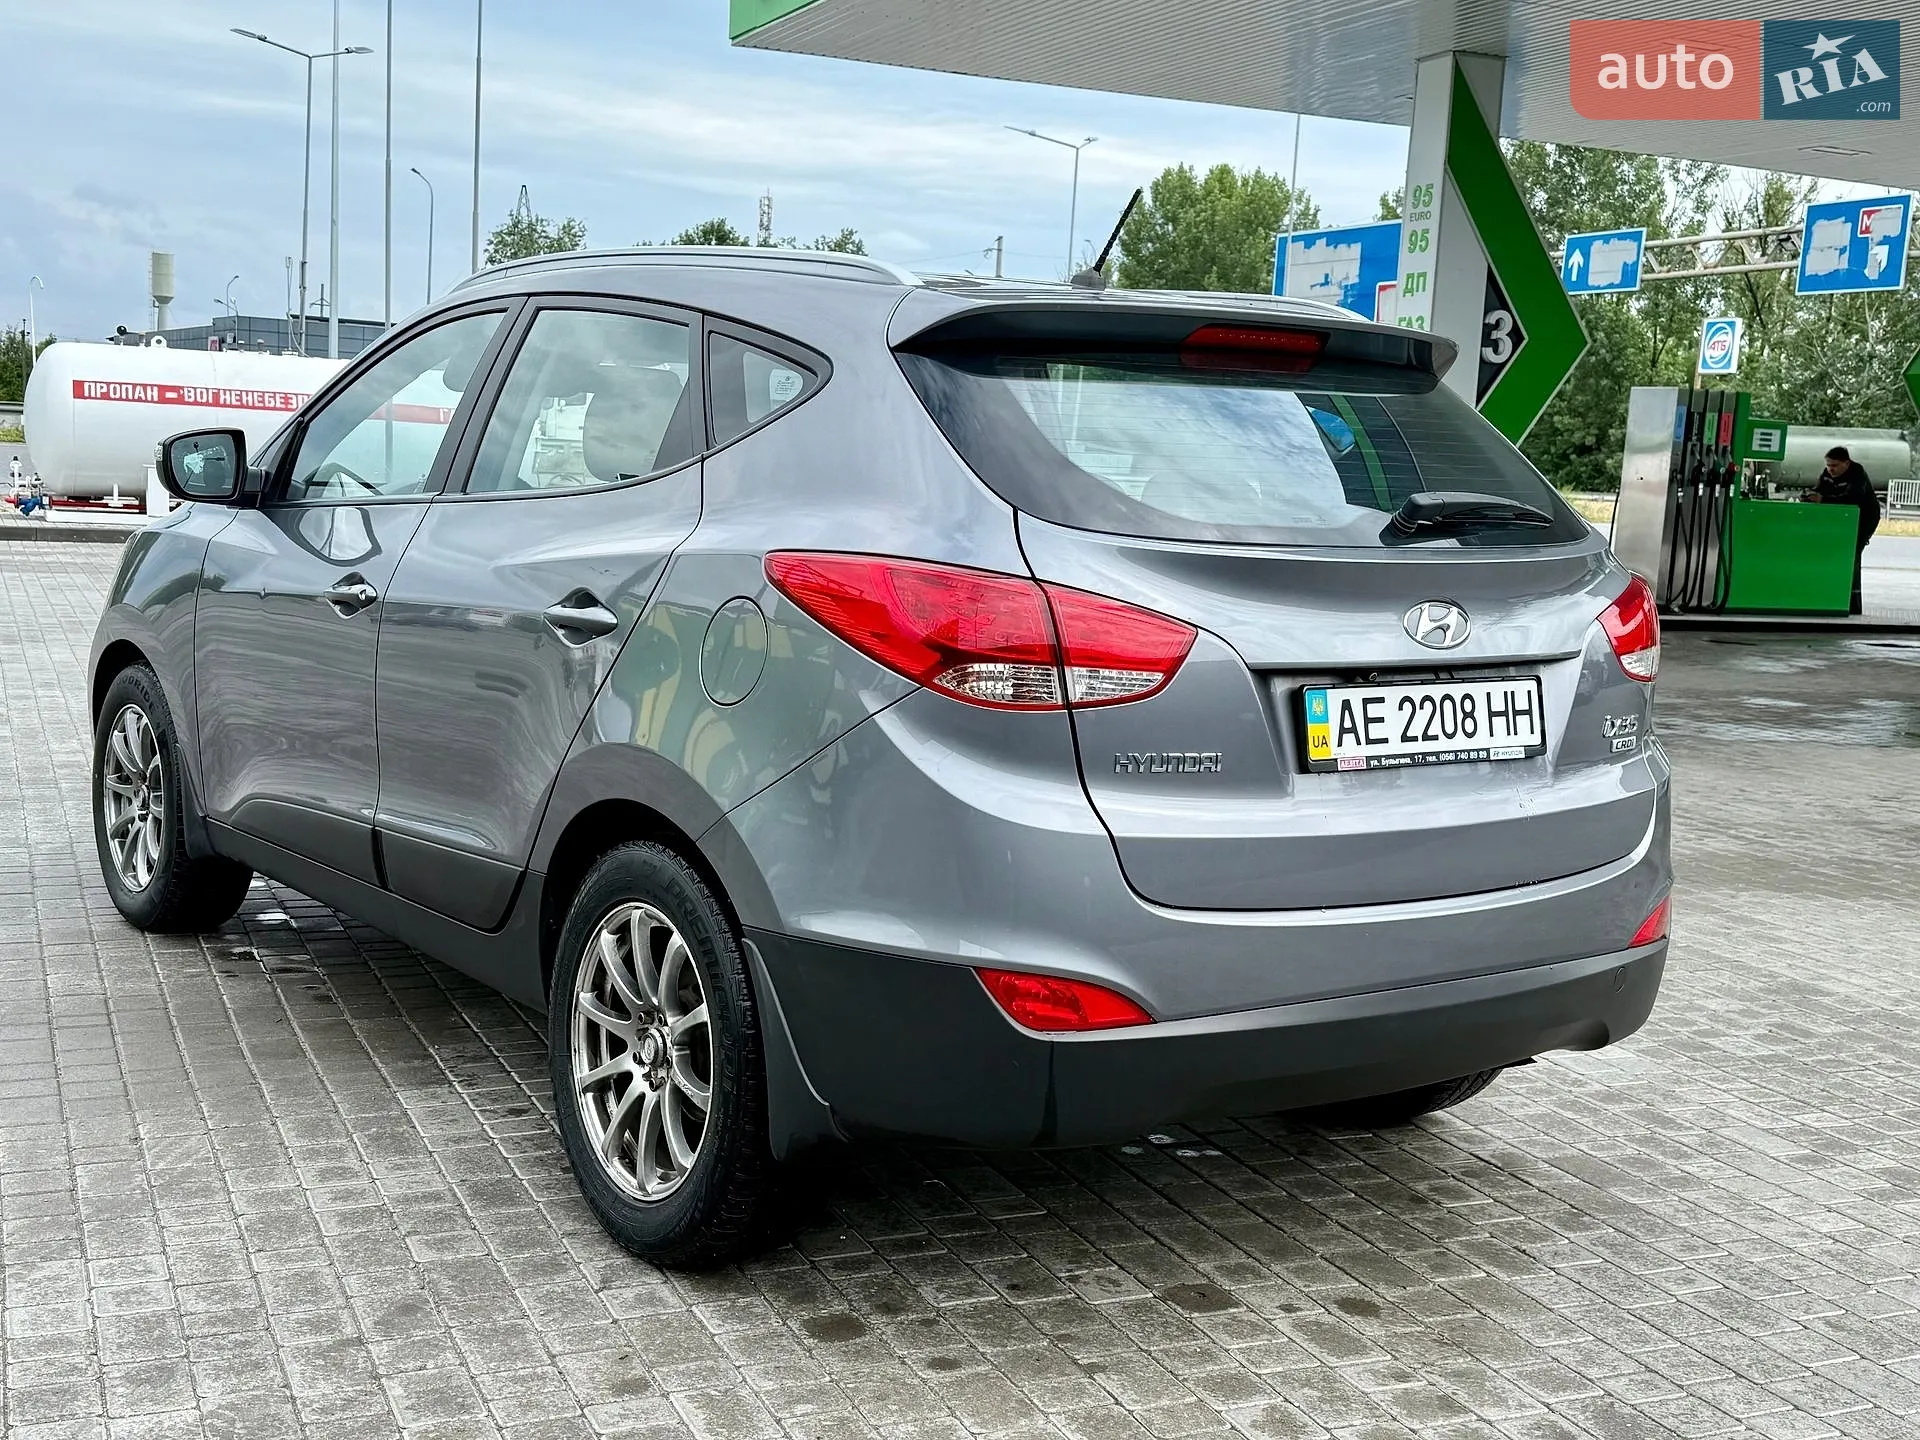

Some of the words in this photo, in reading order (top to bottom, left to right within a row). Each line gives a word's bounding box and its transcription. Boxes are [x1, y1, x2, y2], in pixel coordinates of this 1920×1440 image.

[1411, 183, 1434, 210] 95
[1409, 210, 1432, 222] EURO
[1407, 228, 1430, 254] 95
[1402, 271, 1428, 298] ДП
[1482, 309, 1513, 364] 3
[83, 381, 159, 402] ПРОПАН
[183, 386, 313, 410] ВОГНЕНЕБЕЗП
[1337, 696, 1389, 748] AE
[1397, 692, 1479, 744] 2208
[1485, 689, 1535, 738] HH
[1312, 734, 1329, 749] UA
[1114, 752, 1223, 773] HYUNDAI
[1439, 752, 1456, 761] (056)
[1456, 751, 1469, 760] 740
